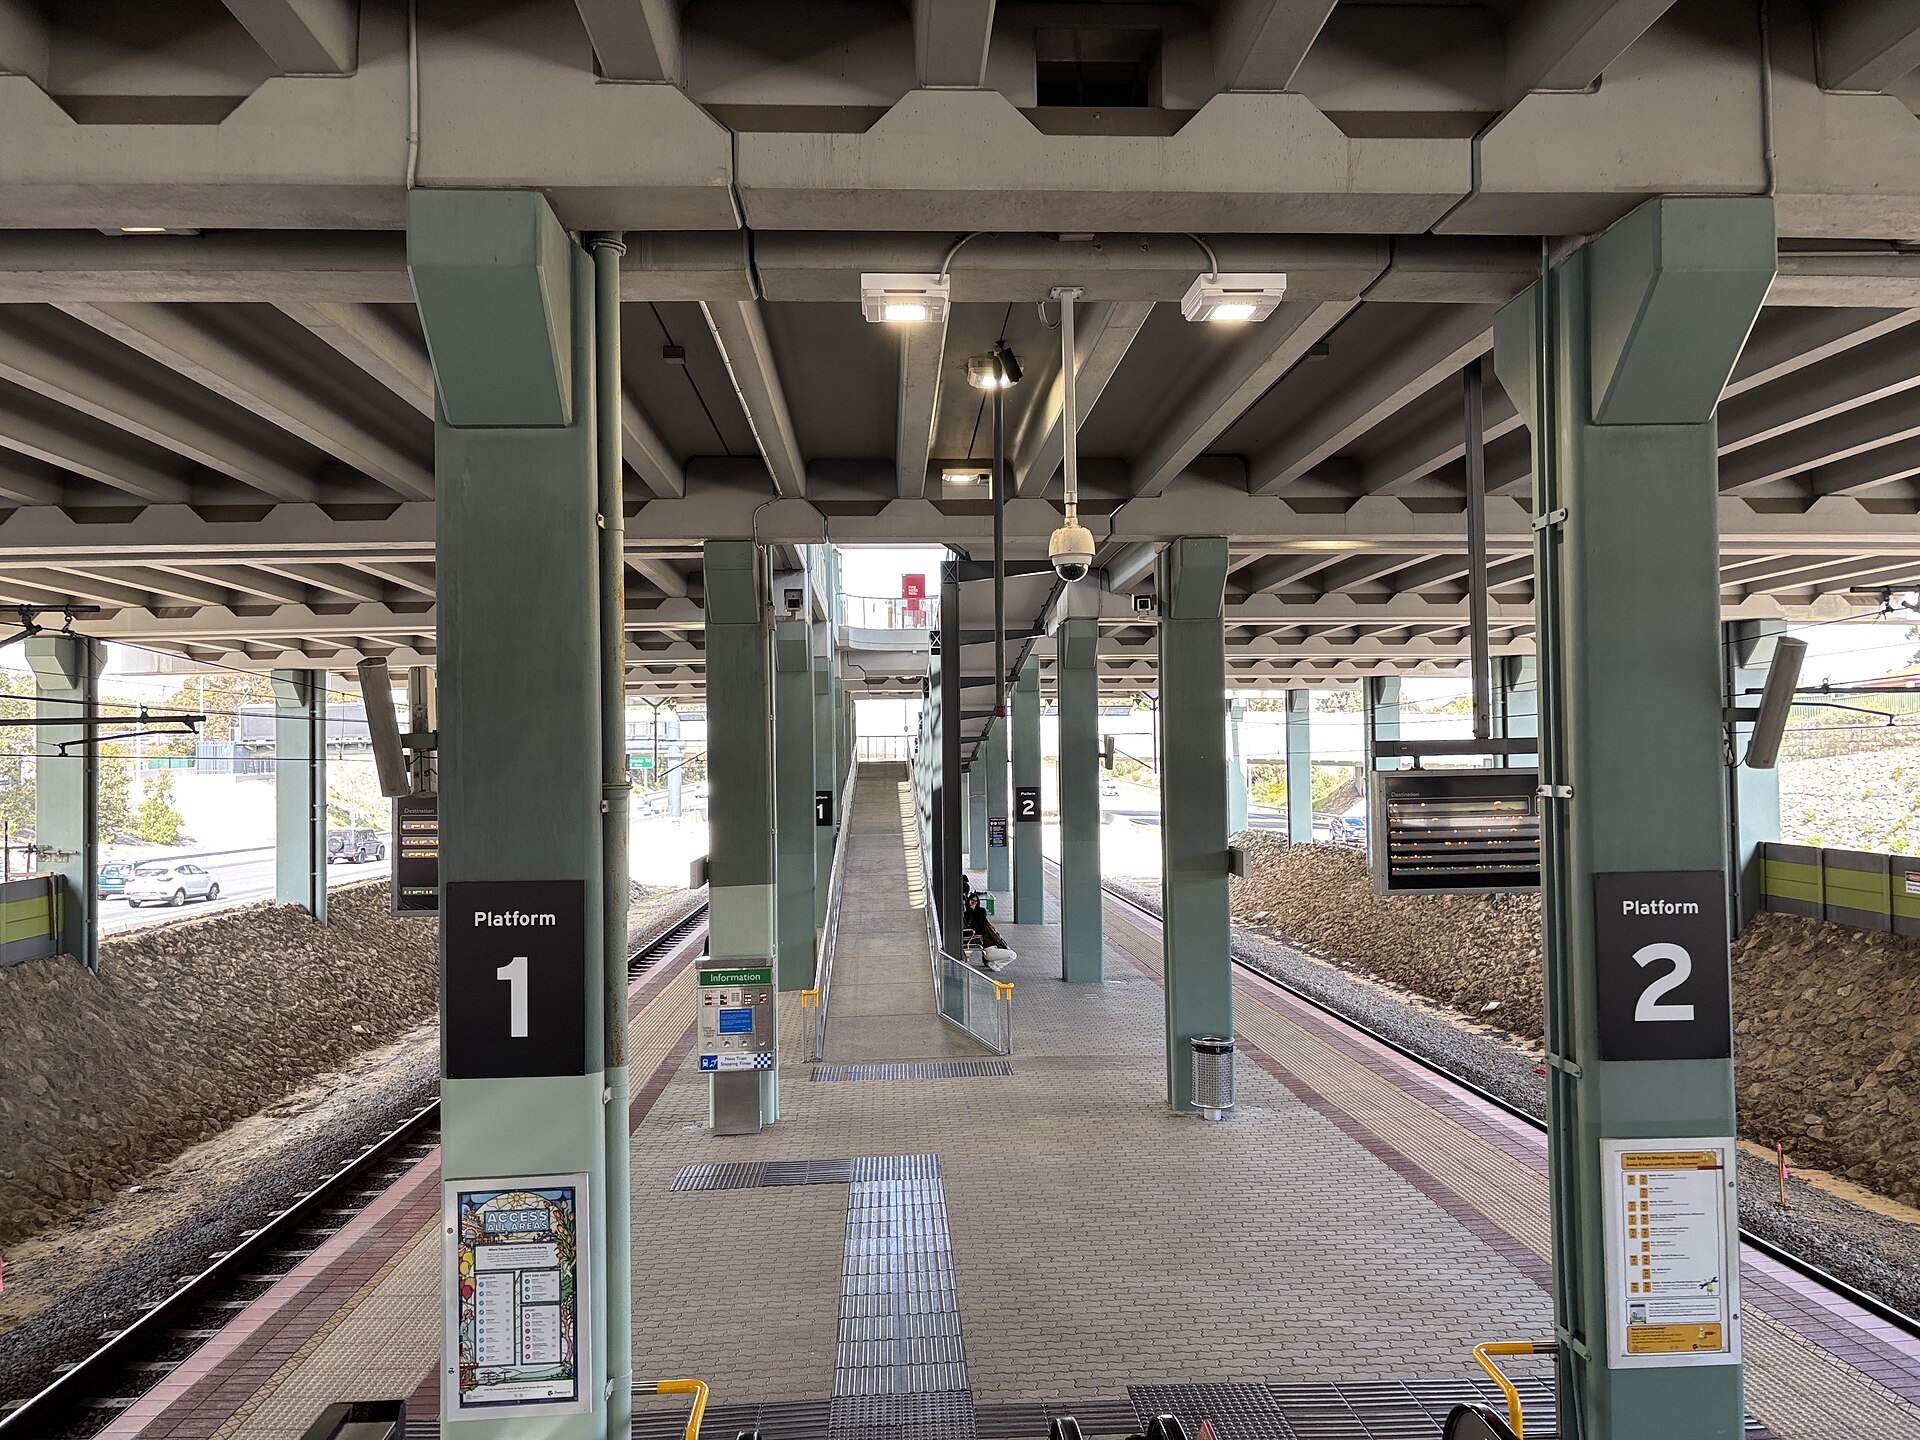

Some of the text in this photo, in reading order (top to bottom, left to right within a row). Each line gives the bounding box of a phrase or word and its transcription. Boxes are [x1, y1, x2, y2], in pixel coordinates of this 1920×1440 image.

[816, 803, 824, 819] 1
[1022, 799, 1035, 815] 2
[1622, 900, 1699, 915] Platform
[474, 910, 556, 927] Platform
[710, 972, 761, 982] Information
[1632, 942, 1695, 1022] 2
[496, 956, 528, 1038] 1
[487, 1211, 547, 1223] ACCESS
[487, 1222, 548, 1231] ALL AREAS
